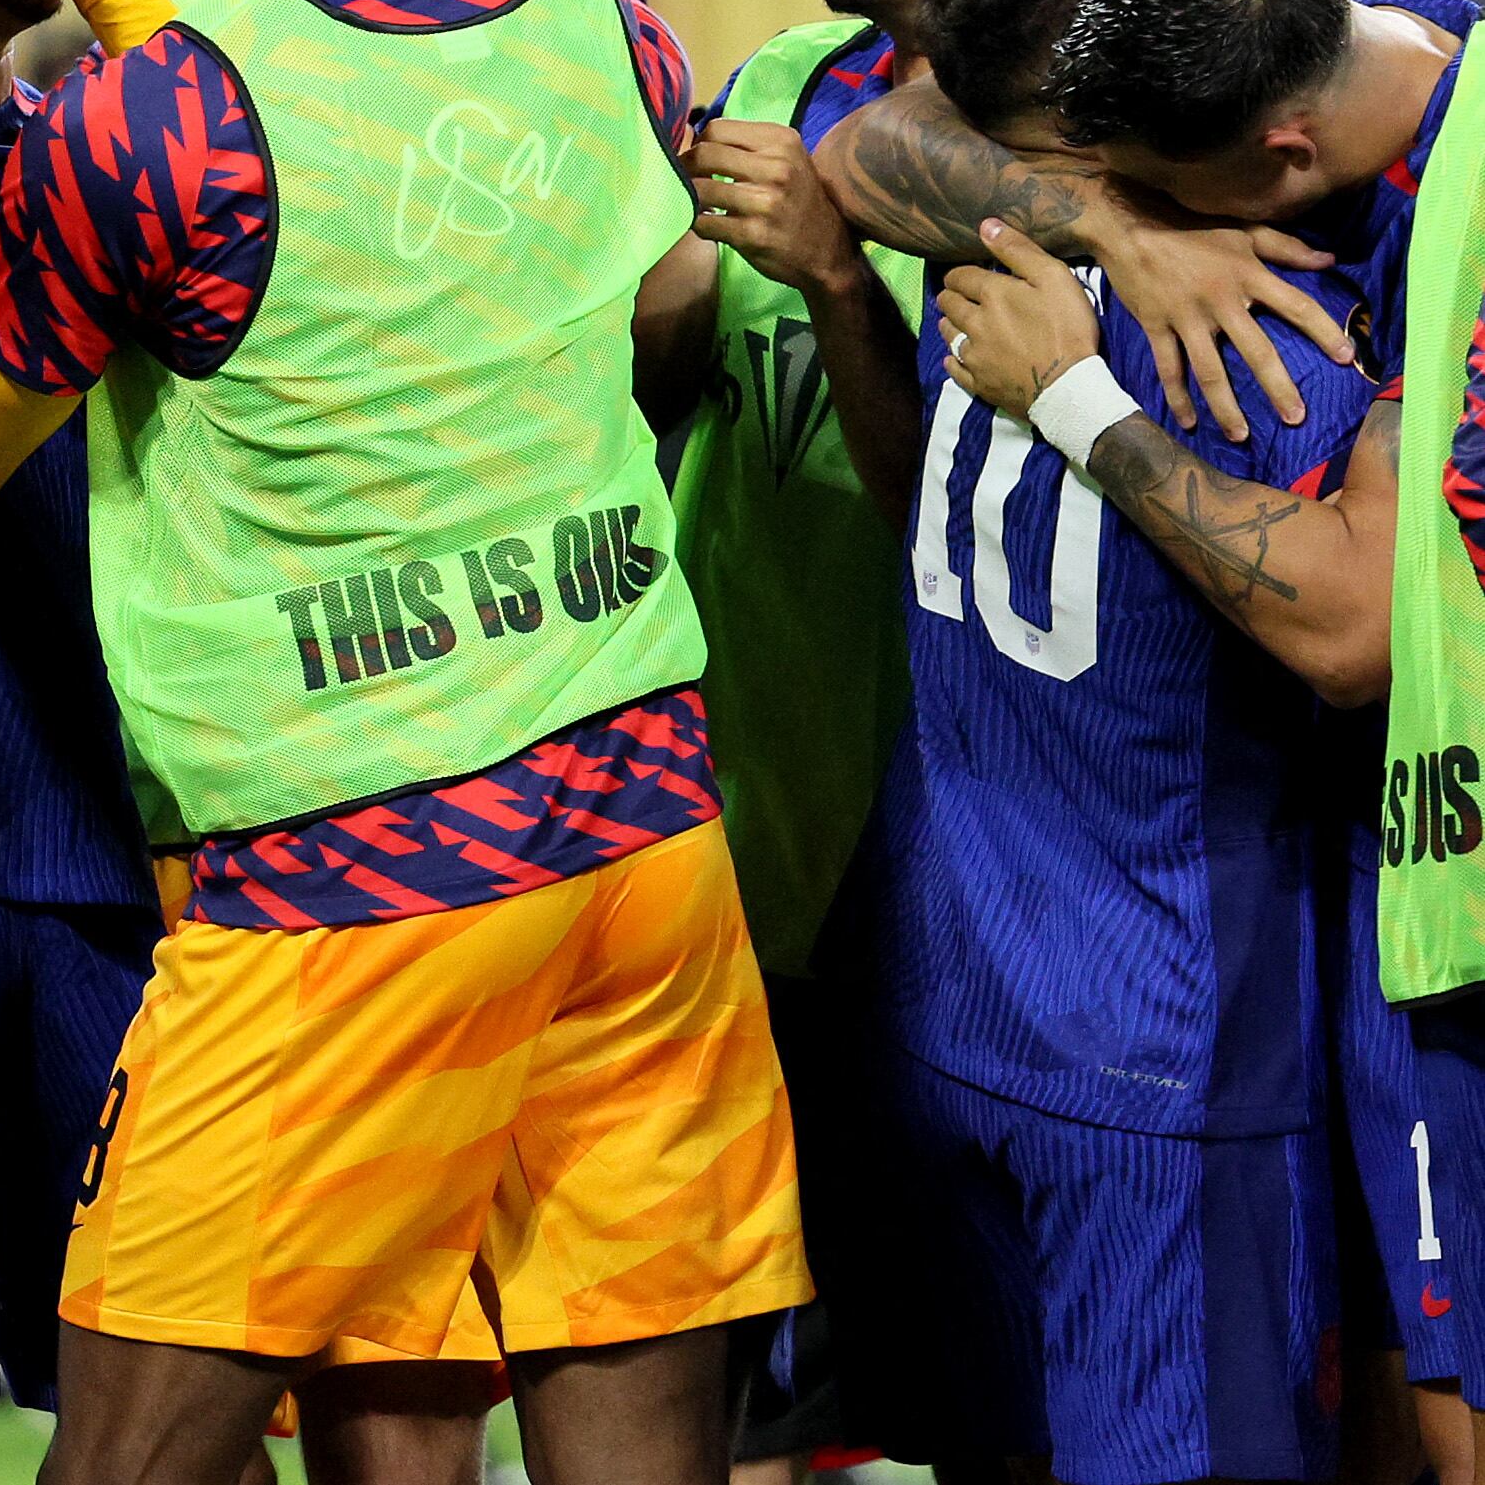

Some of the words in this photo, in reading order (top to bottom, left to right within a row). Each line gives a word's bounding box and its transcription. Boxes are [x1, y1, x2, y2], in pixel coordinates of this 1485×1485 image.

[912, 378, 1103, 682] 10
[275, 560, 457, 692] THIS
[461, 537, 544, 640] IS
[1410, 1121, 1442, 1260] 1
